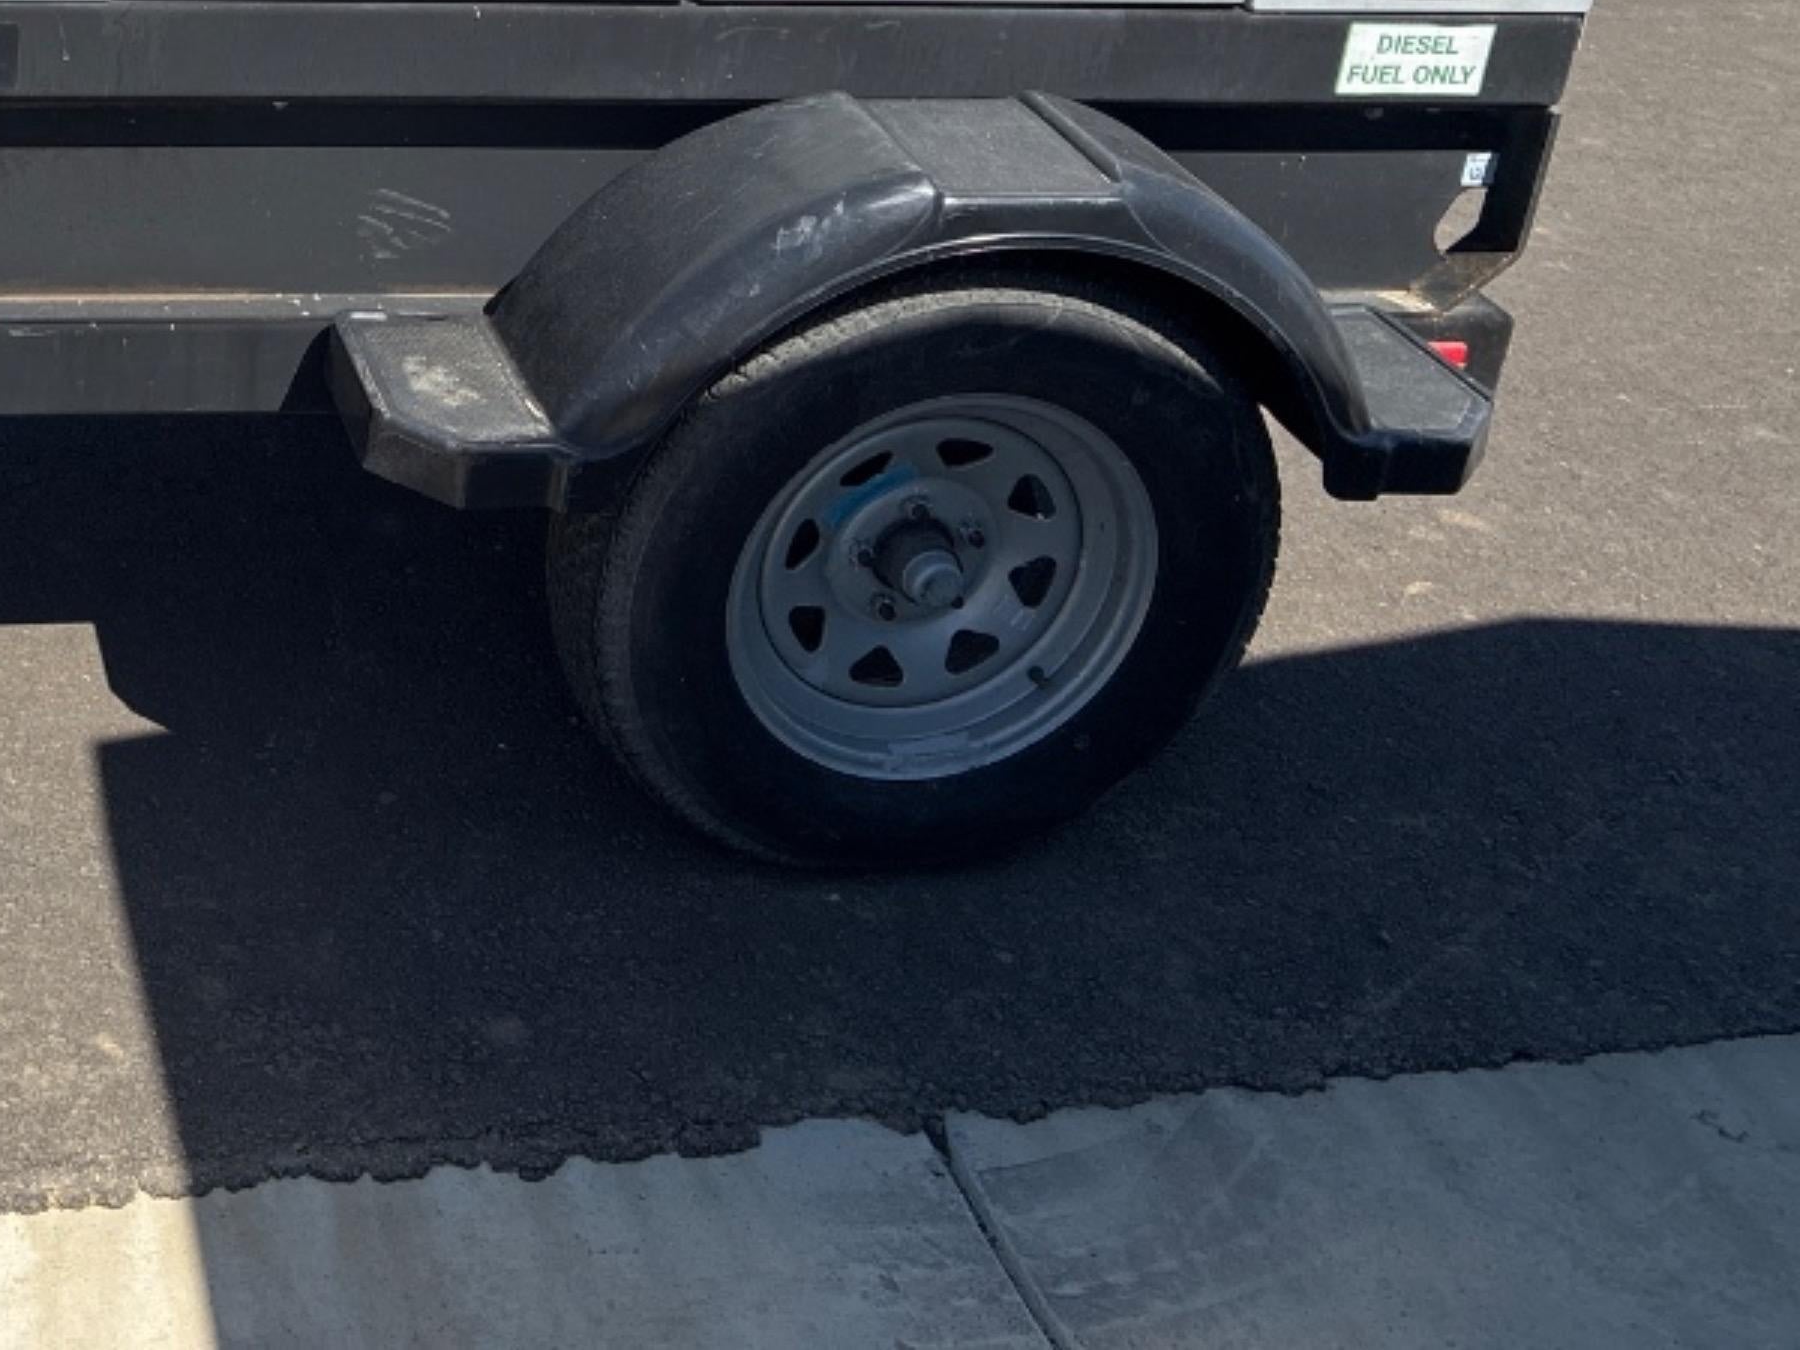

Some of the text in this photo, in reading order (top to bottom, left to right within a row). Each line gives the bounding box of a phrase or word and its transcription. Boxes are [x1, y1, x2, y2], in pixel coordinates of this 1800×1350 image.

[1377, 34, 1460, 55] DIESEL
[1347, 65, 1477, 84] FUEL ONLY
